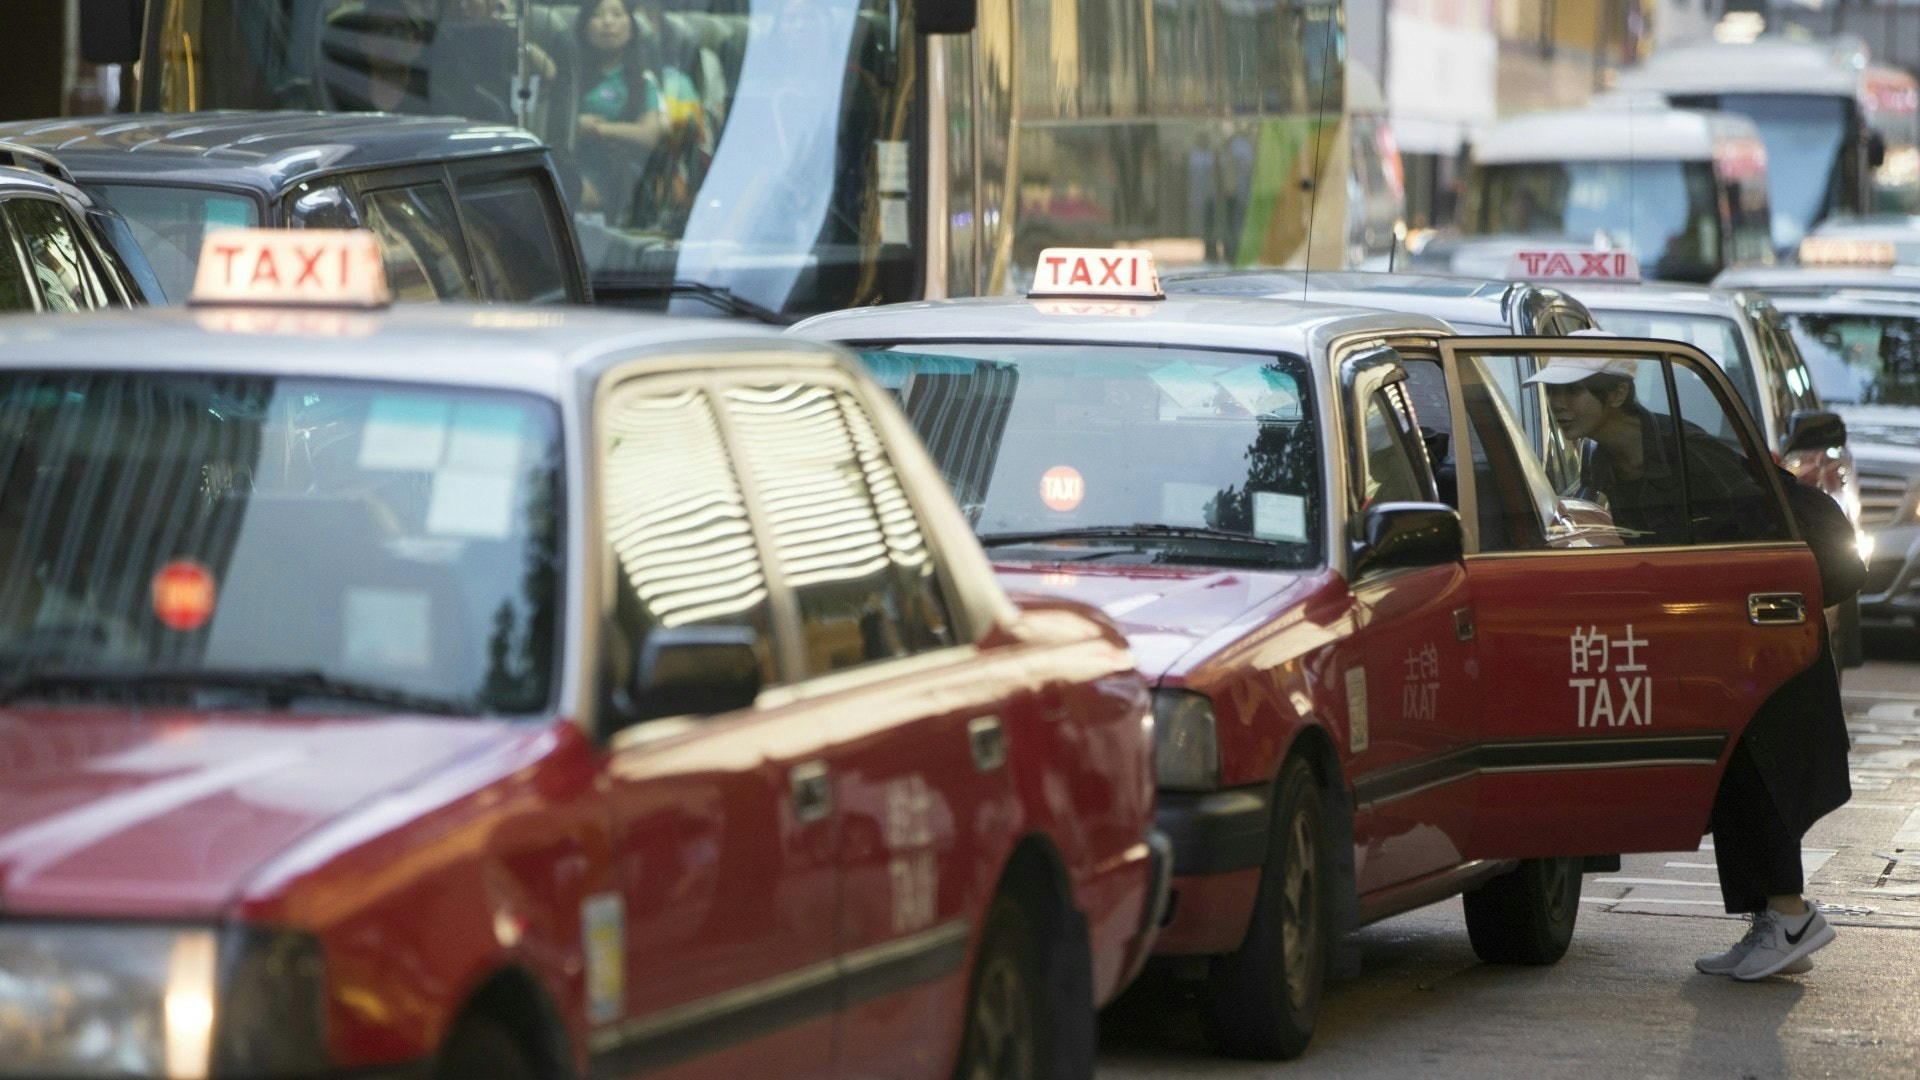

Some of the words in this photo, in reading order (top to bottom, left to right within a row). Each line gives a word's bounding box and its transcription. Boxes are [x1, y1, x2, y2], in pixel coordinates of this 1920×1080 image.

[214, 246, 350, 288] TAXI
[1045, 257, 1138, 286] TAXI
[1519, 252, 1626, 277] TAXI
[1042, 476, 1081, 500] TAXI
[1570, 624, 1649, 673] 的士
[1569, 677, 1652, 728] TAXI
